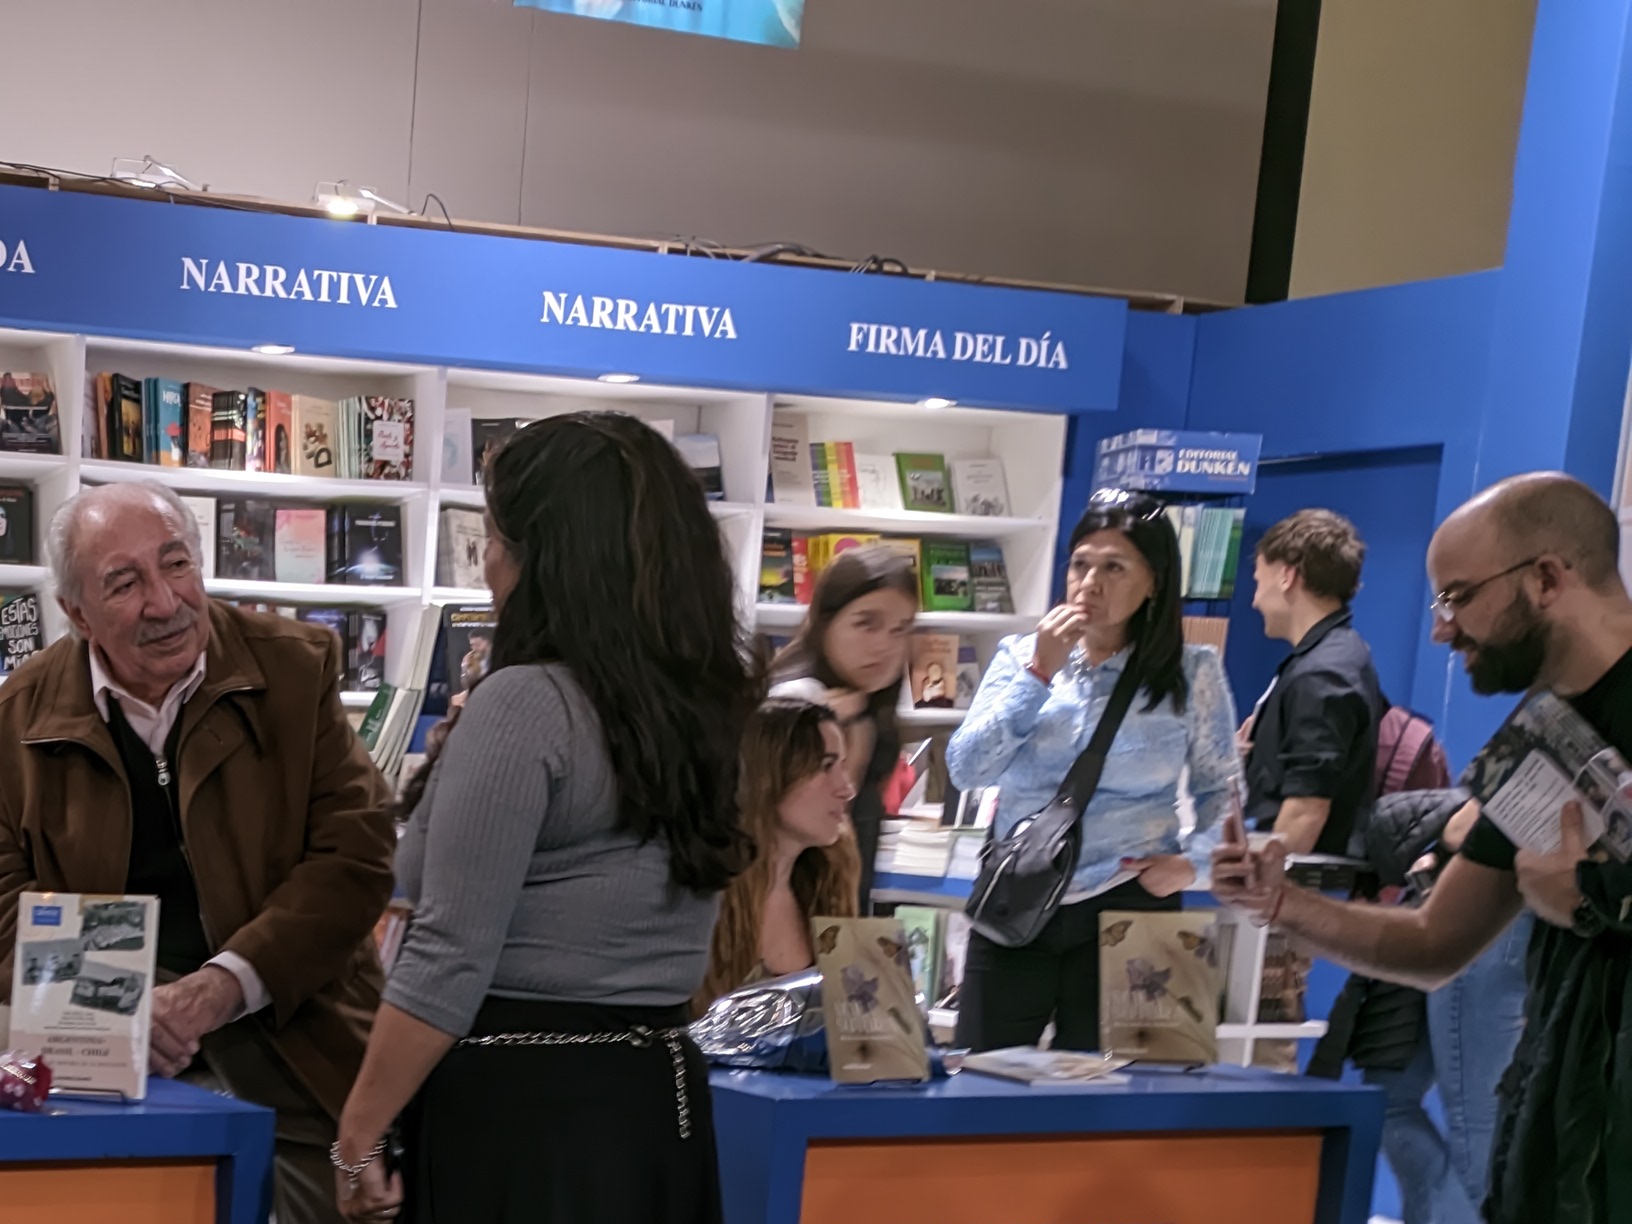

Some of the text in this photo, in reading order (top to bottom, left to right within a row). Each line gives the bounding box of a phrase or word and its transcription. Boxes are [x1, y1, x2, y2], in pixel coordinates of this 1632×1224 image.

[180, 257, 398, 309] NARRATIVA
[540, 290, 737, 339] NARRATIVA
[848, 322, 1067, 369] FIRMA DEL DÍA
[1176, 459, 1252, 476] DUNKEN
[1, 594, 38, 625] ESTAS
[8, 638, 34, 653] SON
